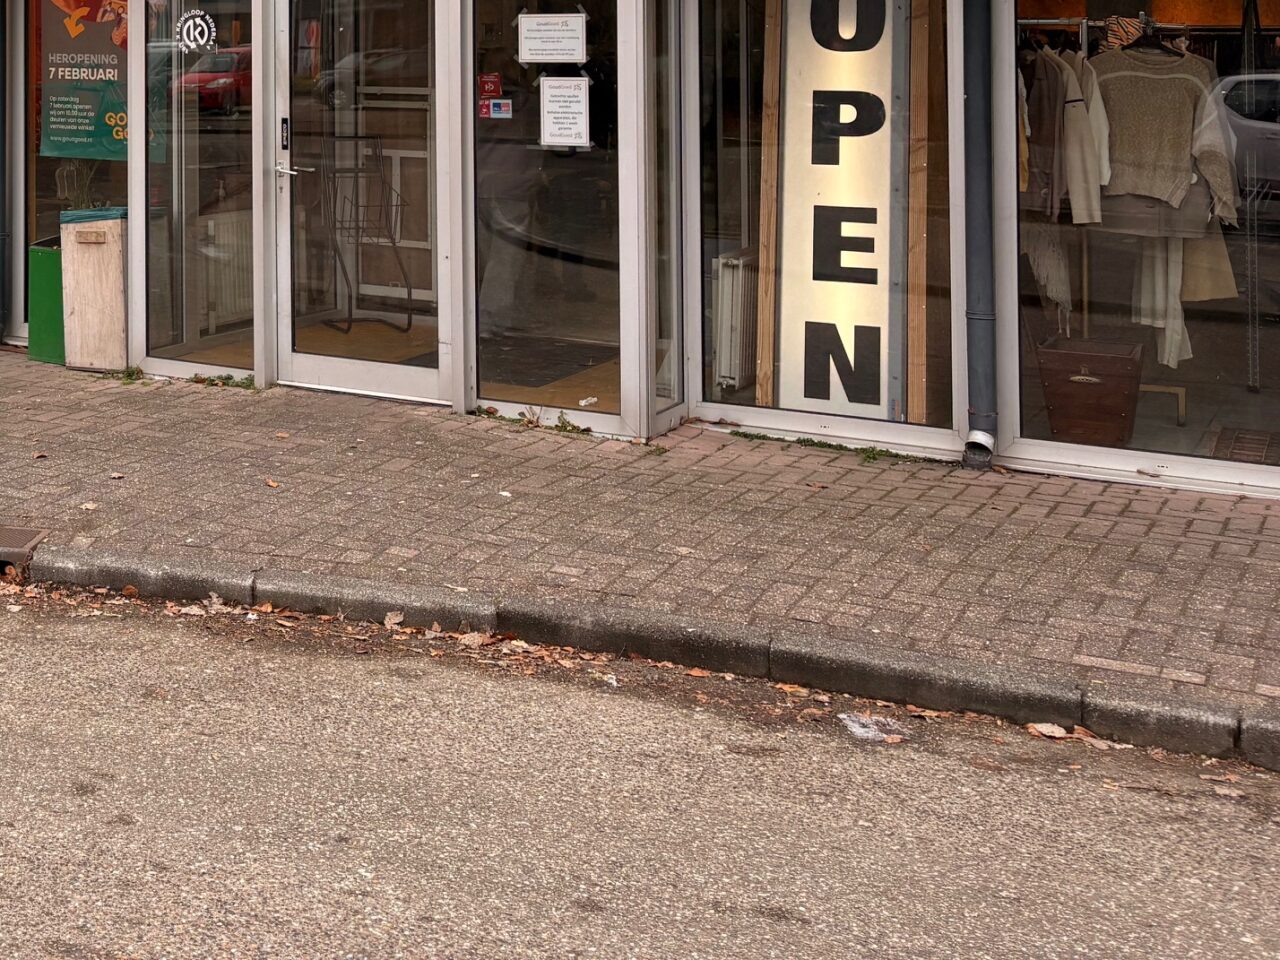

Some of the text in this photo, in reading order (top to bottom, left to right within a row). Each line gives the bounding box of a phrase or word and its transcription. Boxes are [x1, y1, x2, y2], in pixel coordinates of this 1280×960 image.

[175, 9, 205, 32] KRINGLOOP
[49, 52, 118, 65] HEROPENING
[49, 67, 118, 81] 7 FEBRUARI
